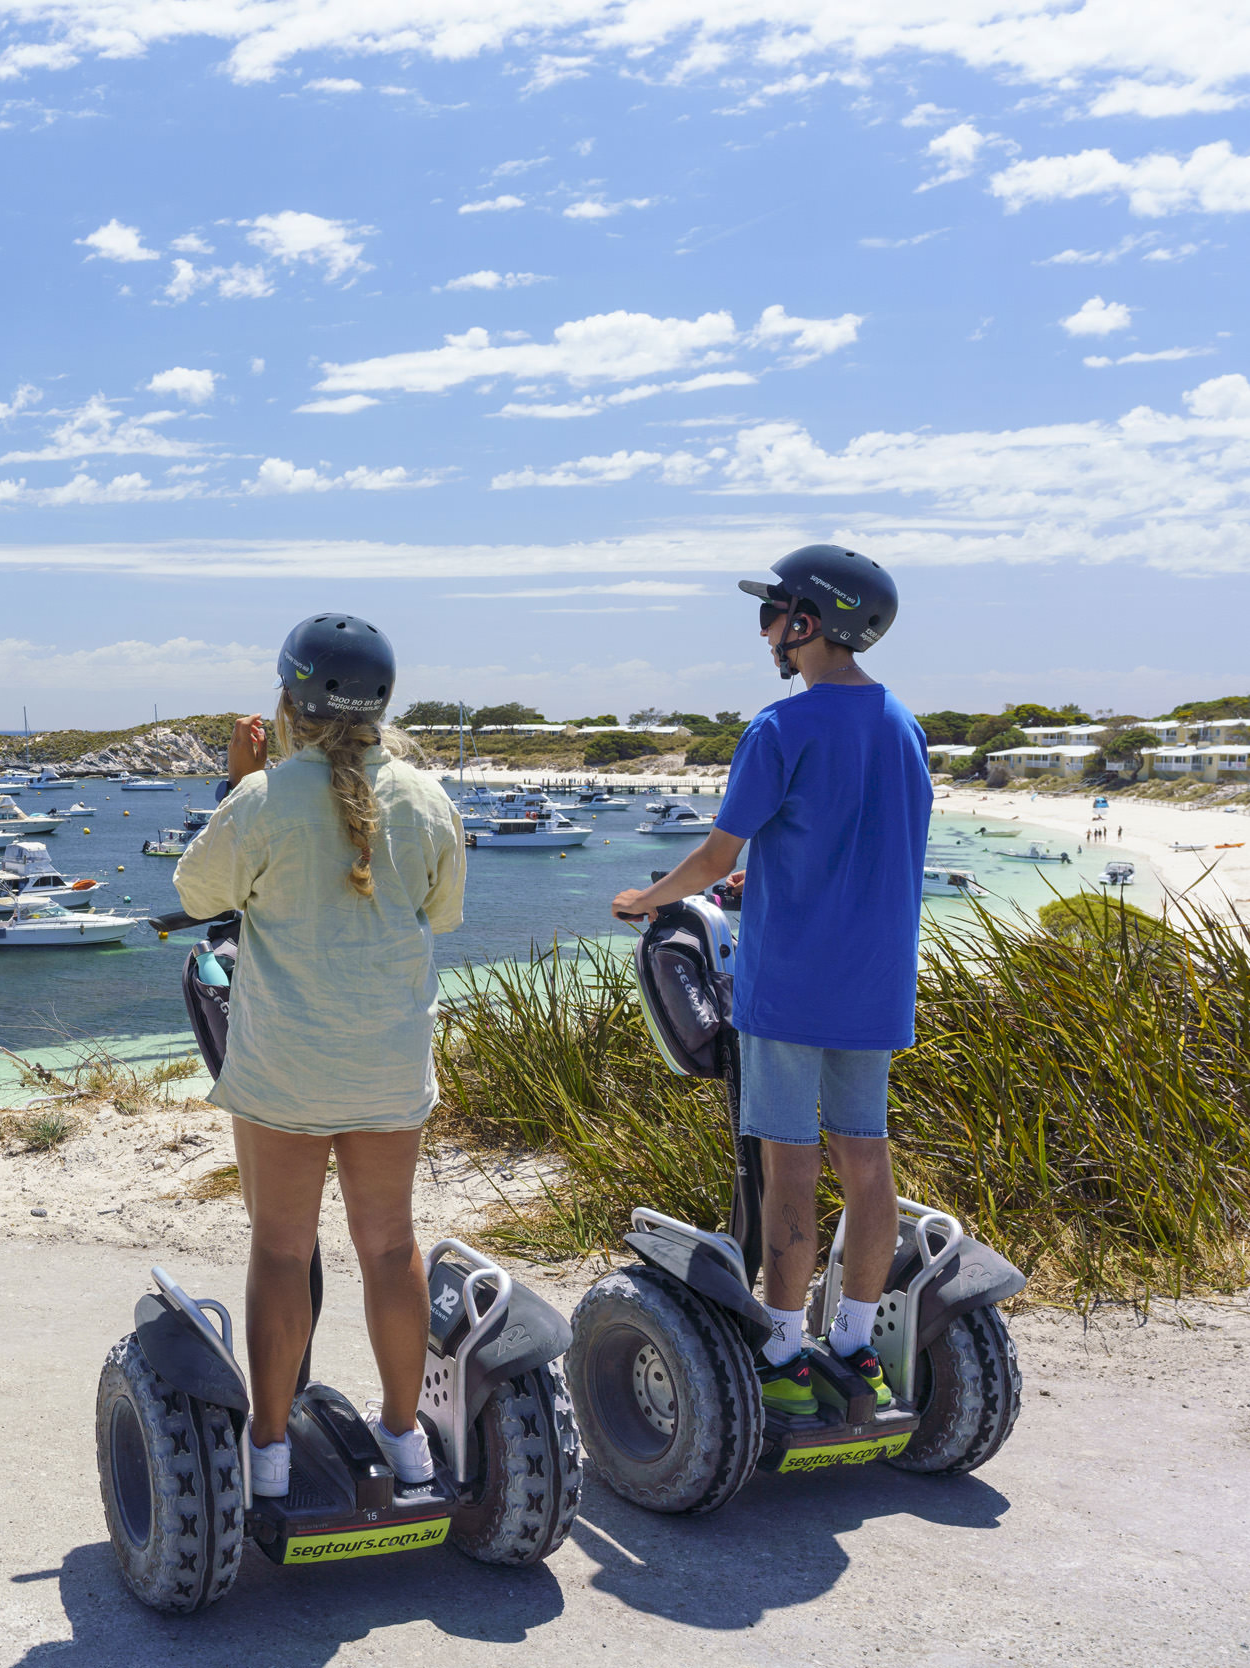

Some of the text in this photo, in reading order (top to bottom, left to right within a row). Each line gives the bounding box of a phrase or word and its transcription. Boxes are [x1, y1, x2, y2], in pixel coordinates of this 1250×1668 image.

[810, 575, 833, 591] segway
[832, 586, 847, 600] tours
[327, 700, 383, 711] segtours.com.au
[329, 695, 350, 704] 1300
[206, 986, 230, 1018] SEG
[672, 963, 715, 1030] SEGWAY
[785, 1442, 904, 1467] segtours.comau
[367, 1511, 378, 1521] 15
[290, 1528, 444, 1558] segtours.com.au
